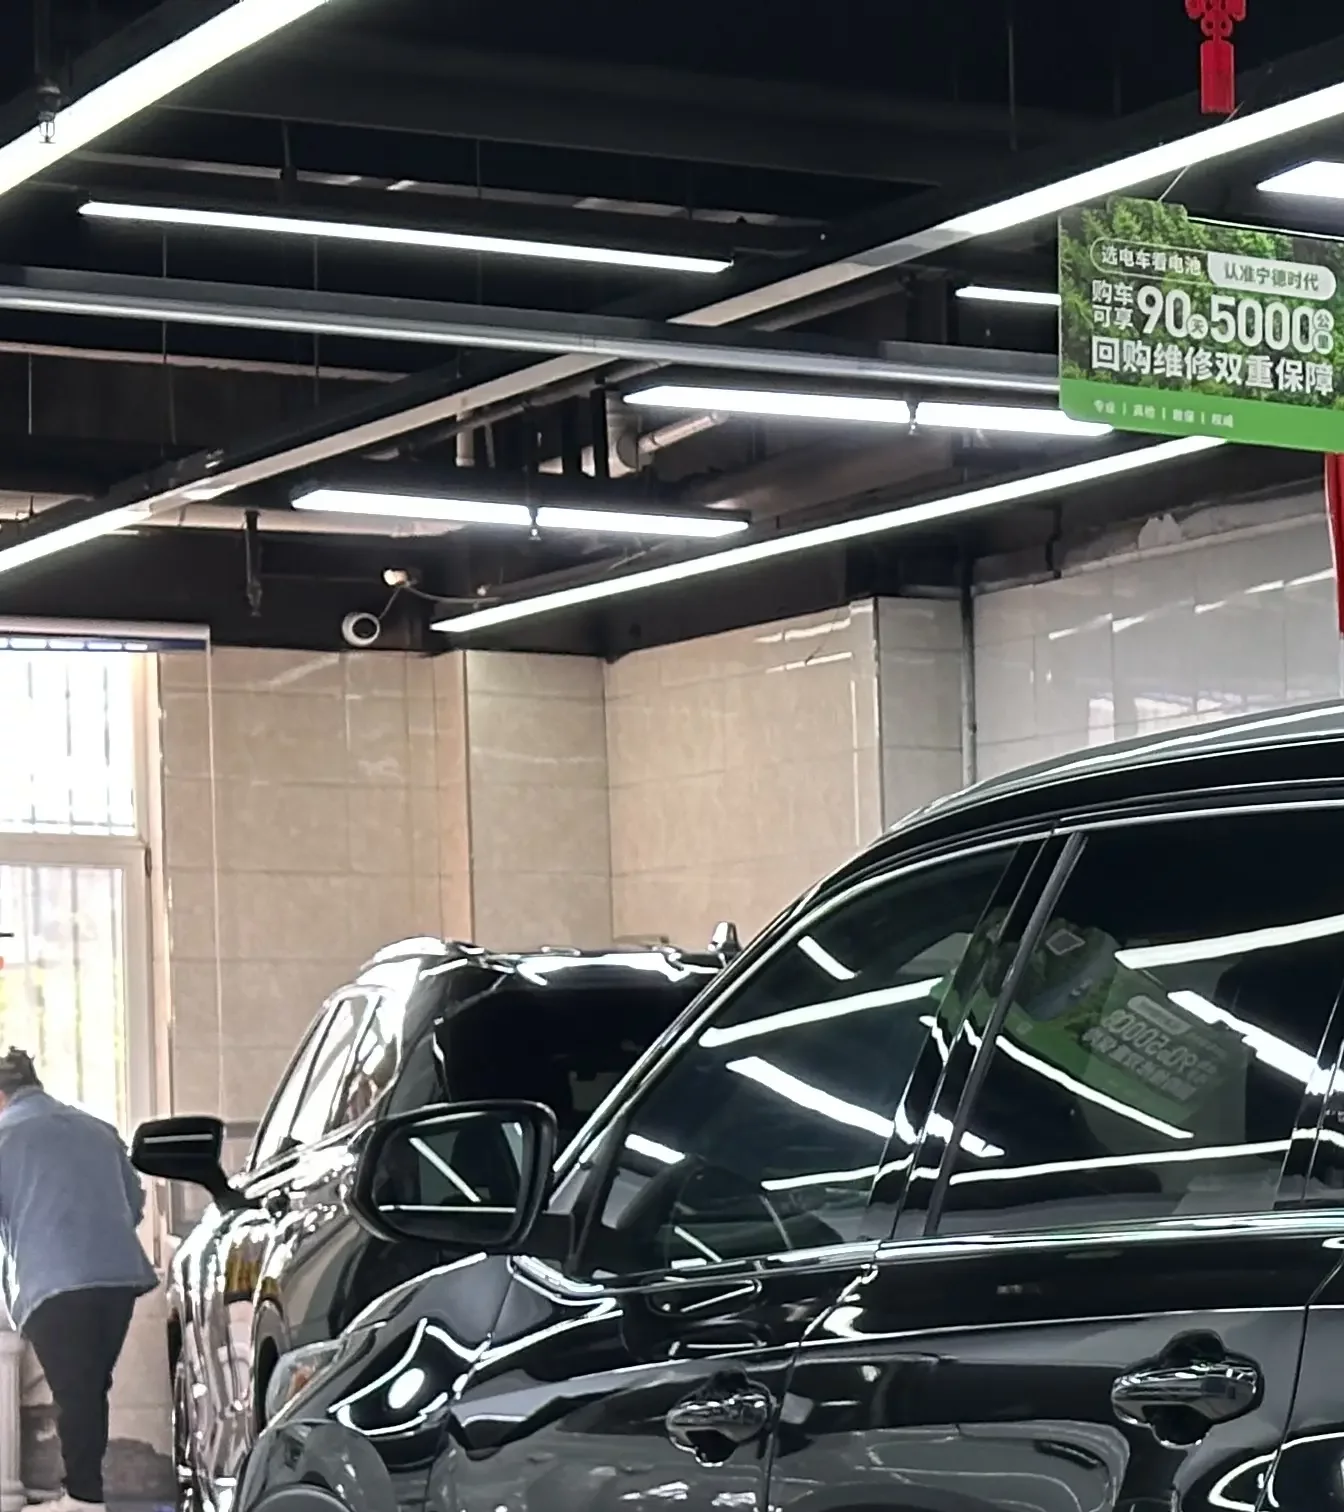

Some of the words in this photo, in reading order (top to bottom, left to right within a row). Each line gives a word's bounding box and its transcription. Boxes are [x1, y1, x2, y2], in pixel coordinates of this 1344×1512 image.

[1101, 247, 1201, 276] 选电车看电池
[1224, 261, 1320, 291] 认准宁德时代
[1092, 280, 1133, 305] 购车
[1092, 335, 1334, 396] 回购维修双重保障
